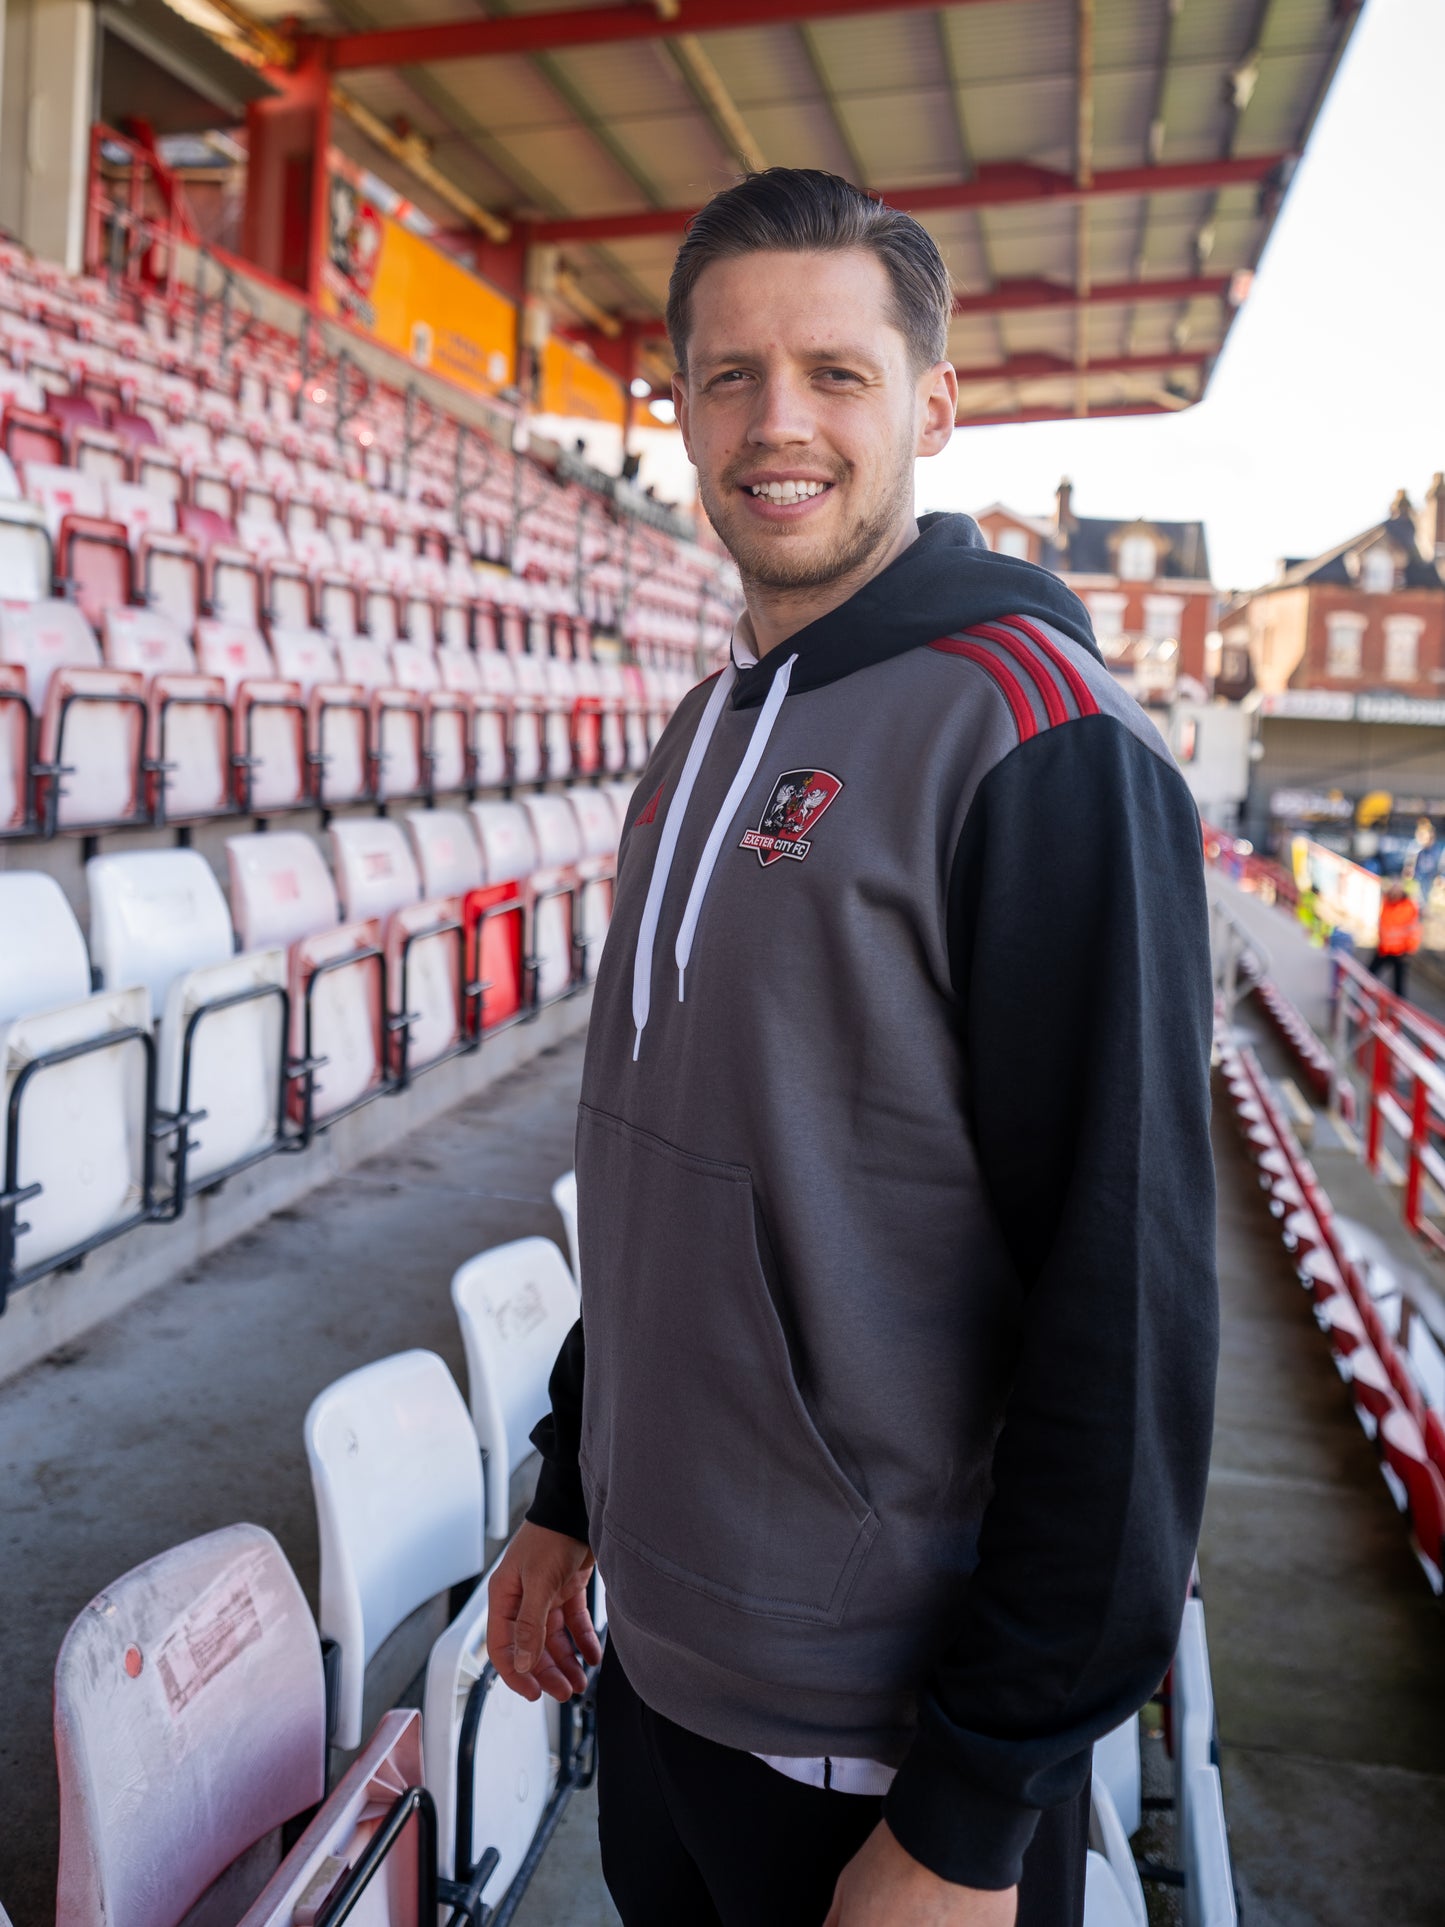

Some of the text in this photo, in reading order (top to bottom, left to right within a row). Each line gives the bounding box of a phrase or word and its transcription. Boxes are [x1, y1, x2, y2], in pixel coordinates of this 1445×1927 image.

[744, 834, 805, 855] EXETER CITY FC
